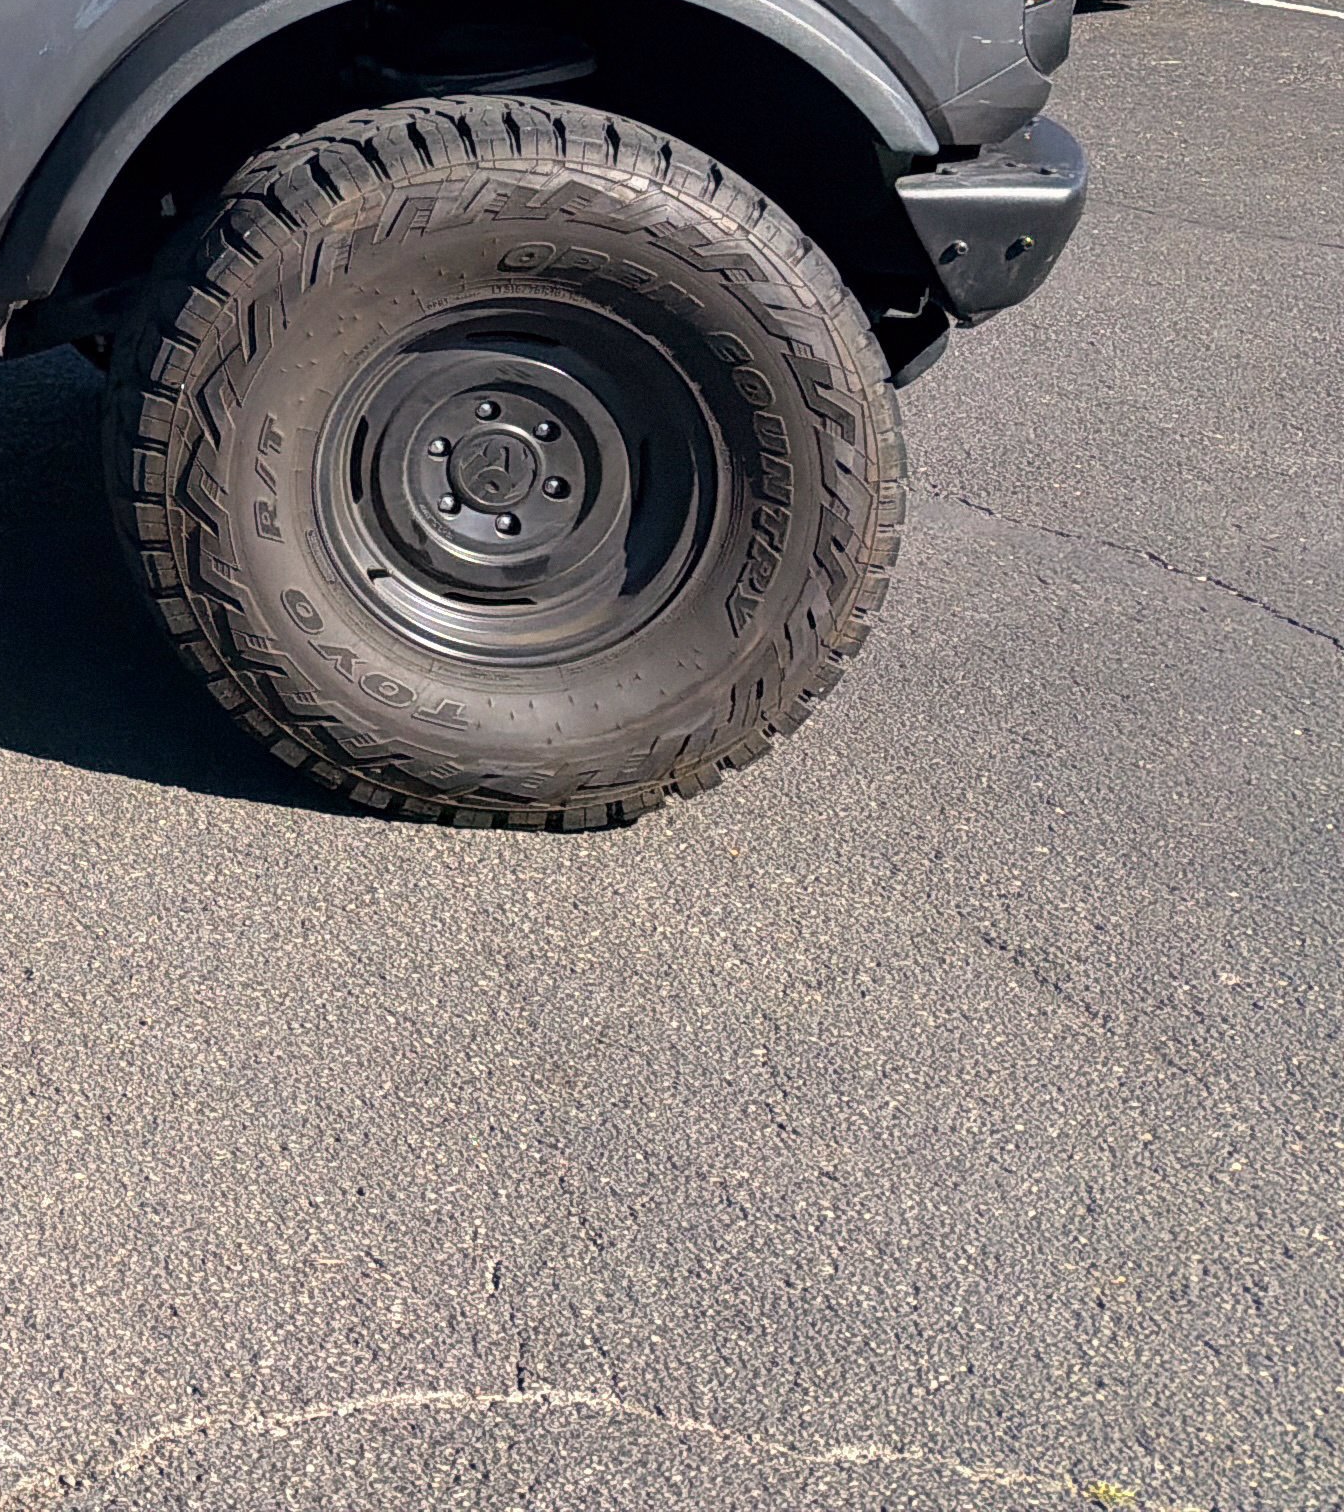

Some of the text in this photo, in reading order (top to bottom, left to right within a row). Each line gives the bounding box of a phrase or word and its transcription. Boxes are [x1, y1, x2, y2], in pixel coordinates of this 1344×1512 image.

[255, 413, 285, 543] R/T
[497, 242, 794, 638] OPEN COUNTRY
[281, 588, 473, 731] TOYO
